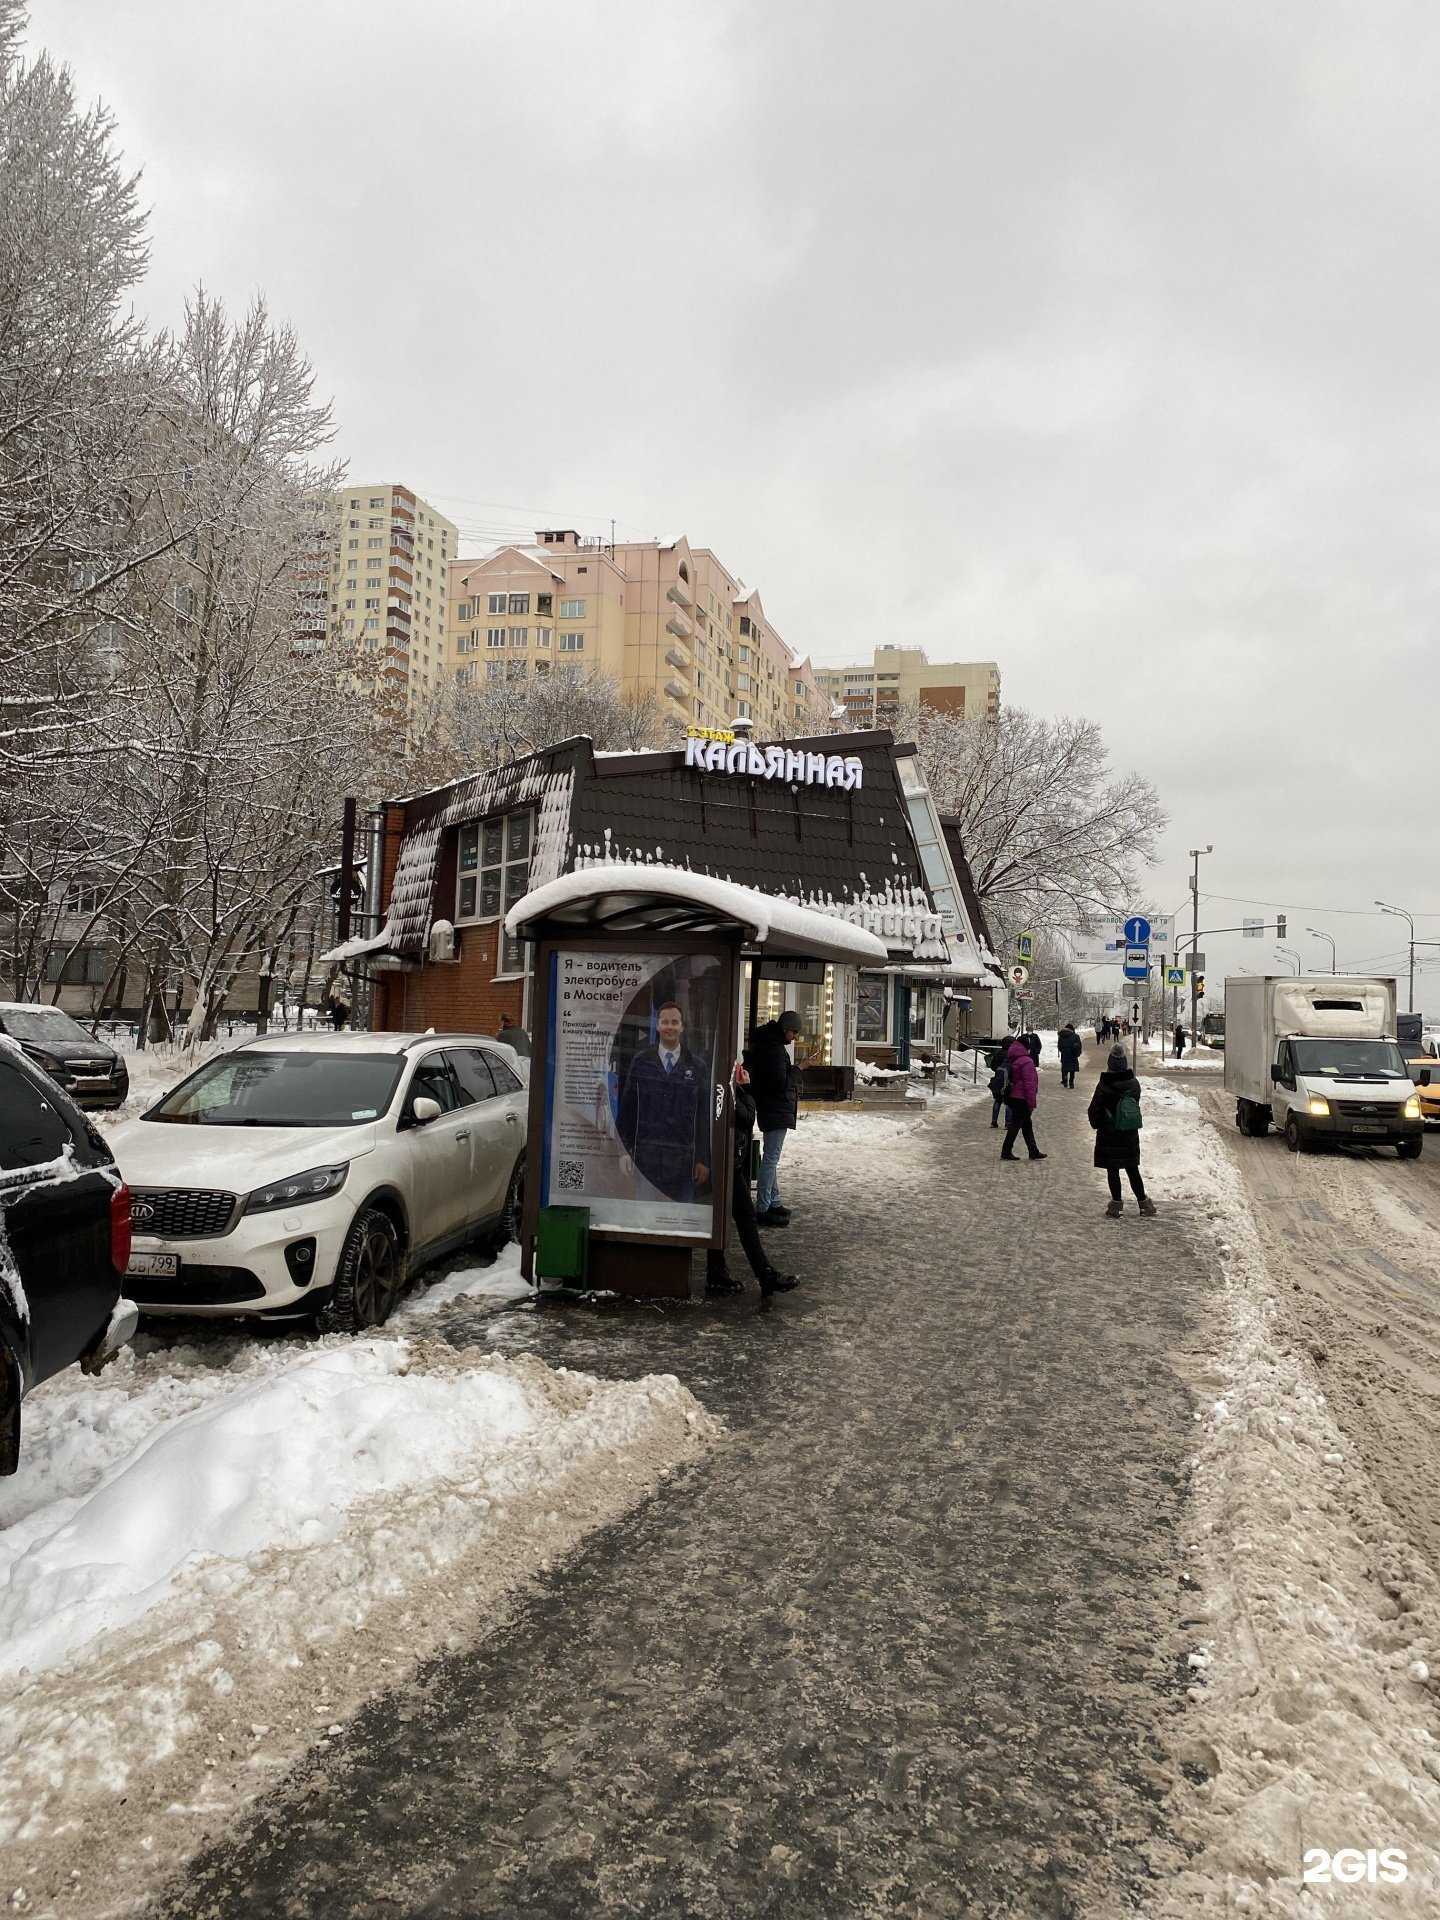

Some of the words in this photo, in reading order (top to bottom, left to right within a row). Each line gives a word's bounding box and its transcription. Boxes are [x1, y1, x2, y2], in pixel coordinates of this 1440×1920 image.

[700, 728, 734, 744] ЭТАЖ
[685, 738, 863, 790] КАЛЬЯННАЯ
[565, 959, 573, 969] Я
[587, 962, 642, 972] водитель
[563, 975, 638, 989] электробуса
[564, 992, 571, 1000] в
[573, 989, 623, 1001] Москве!
